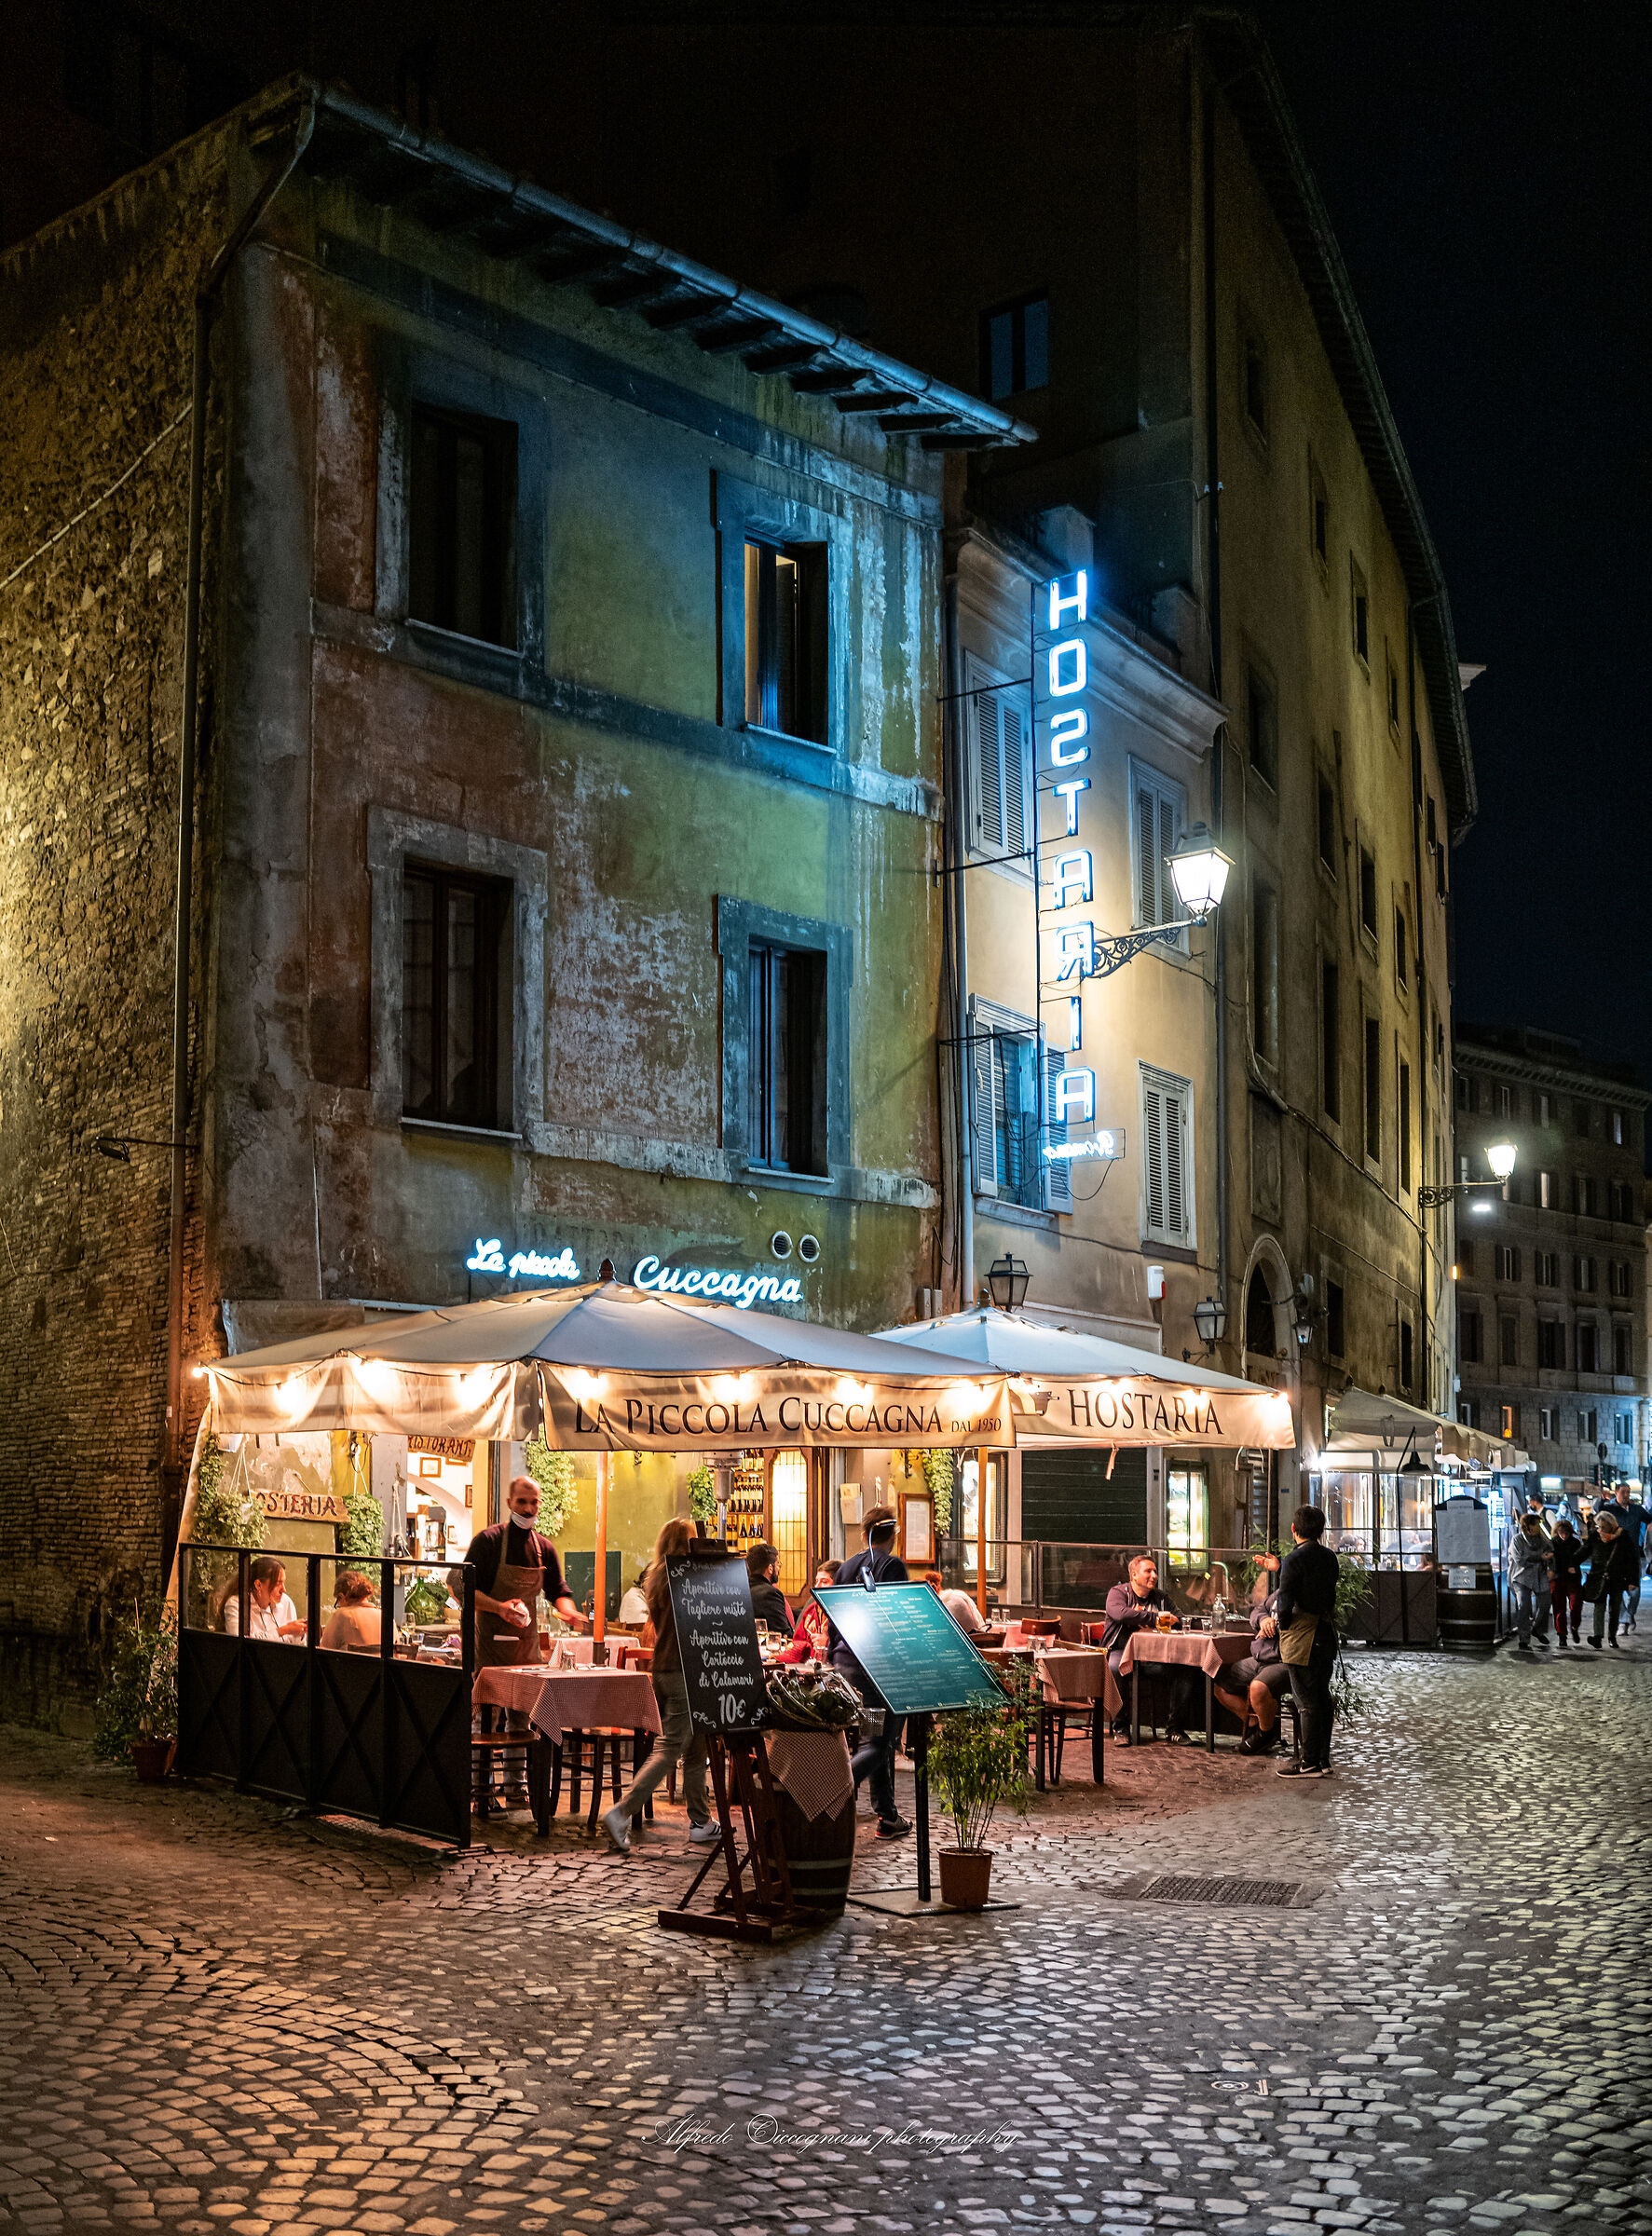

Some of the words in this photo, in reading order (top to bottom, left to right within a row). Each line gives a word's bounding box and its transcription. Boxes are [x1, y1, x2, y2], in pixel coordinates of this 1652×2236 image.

[466, 1238, 507, 1274] La
[633, 1255, 803, 1308] Cuccagna
[574, 1398, 614, 1435] LA
[622, 1398, 770, 1436] PICCOLA
[778, 1397, 943, 1434] CUCCAGNA
[950, 1418, 976, 1433] DAL
[976, 1417, 1003, 1433] 1950
[1066, 1388, 1224, 1435] HOSTARIA
[682, 1578, 725, 1598] Aperitivo
[726, 1586, 742, 1596] con
[681, 1597, 722, 1619] Tagliere
[724, 1601, 746, 1616] misto
[689, 1629, 732, 1649] Aperitivo
[733, 1636, 749, 1646] con
[702, 1651, 744, 1668] Cartoccio
[699, 1672, 710, 1687] di
[711, 1671, 754, 1688] Calamari
[718, 1694, 746, 1725] 10€
